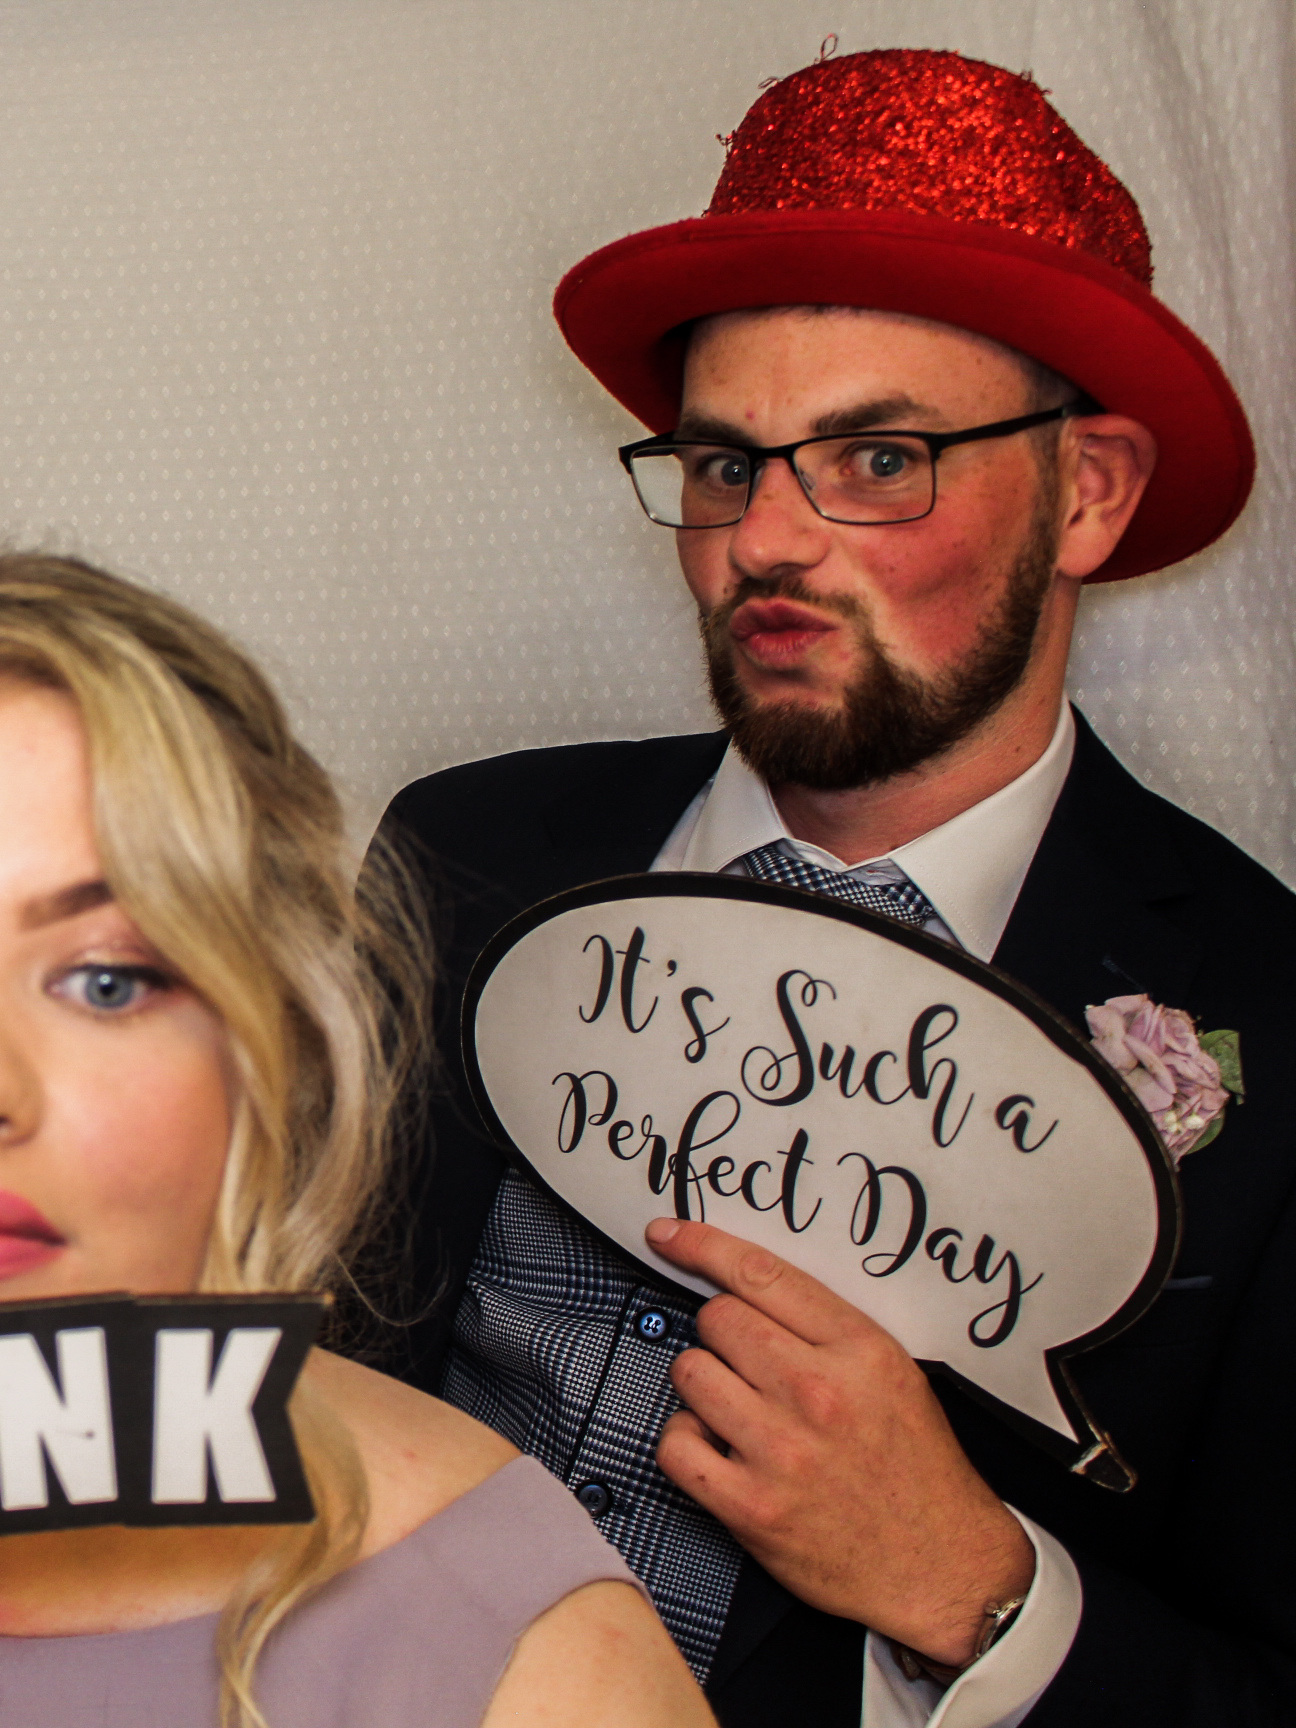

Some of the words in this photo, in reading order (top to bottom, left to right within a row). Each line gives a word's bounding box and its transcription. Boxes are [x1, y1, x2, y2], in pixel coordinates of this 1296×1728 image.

[578, 926, 731, 1064] It's
[741, 969, 974, 1148] Such
[995, 1093, 1060, 1153] a
[551, 1070, 823, 1234] Perfect
[837, 1152, 1044, 1348] Day
